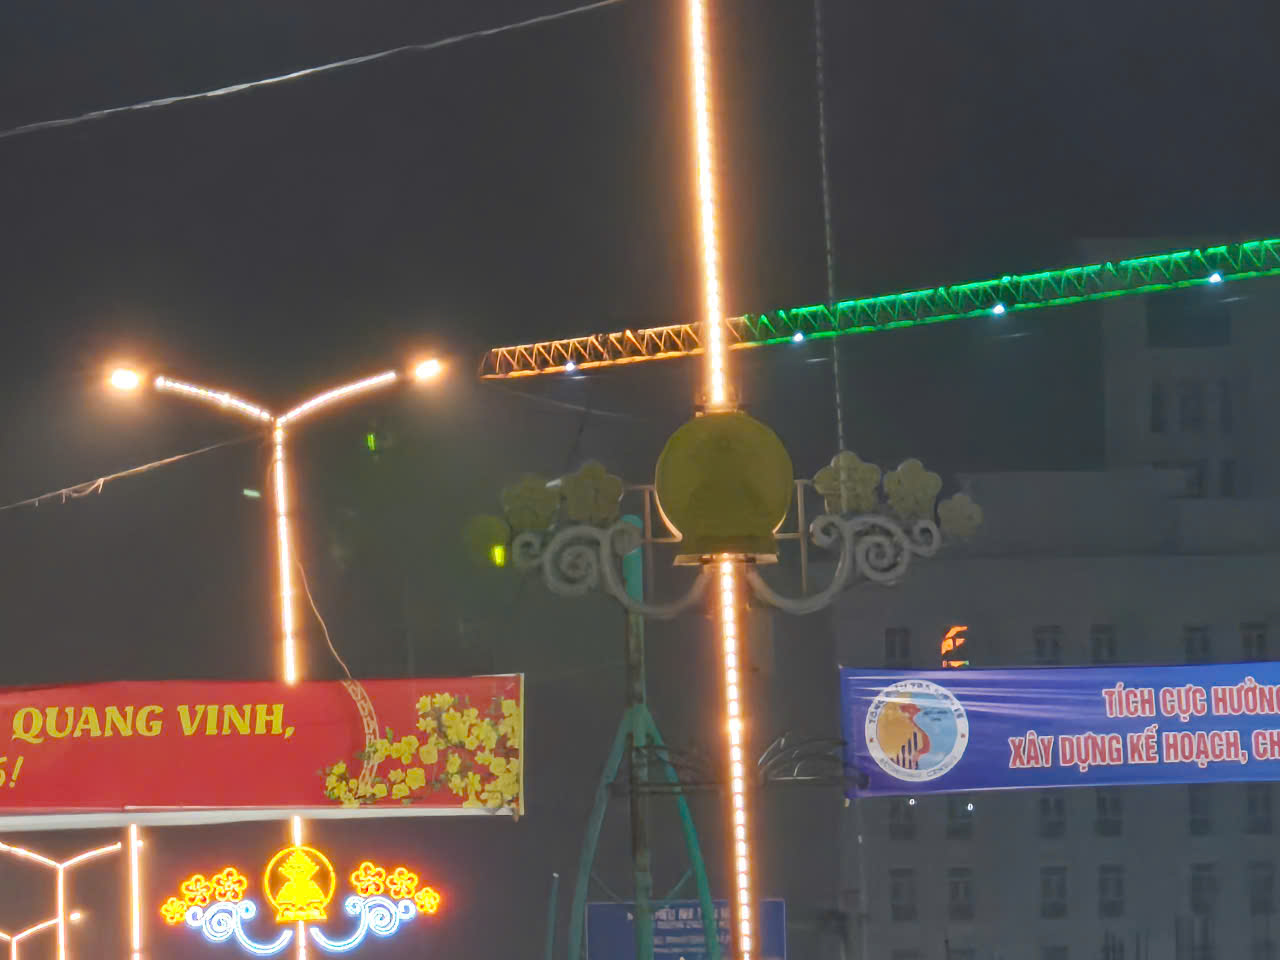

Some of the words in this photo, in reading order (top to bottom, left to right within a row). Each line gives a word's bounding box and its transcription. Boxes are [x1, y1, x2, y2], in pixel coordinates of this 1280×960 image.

[1102, 681, 1156, 718] TÍCH
[1159, 684, 1207, 722] CỰC
[1211, 676, 1280, 716] HƯỞN
[11, 704, 165, 744] QUANG
[176, 703, 296, 739] VINH,
[1008, 730, 1054, 768] XÂY
[1059, 732, 1123, 773] DỰNG
[1127, 723, 1159, 764] KẾ
[1163, 730, 1249, 768] HOẠCH,
